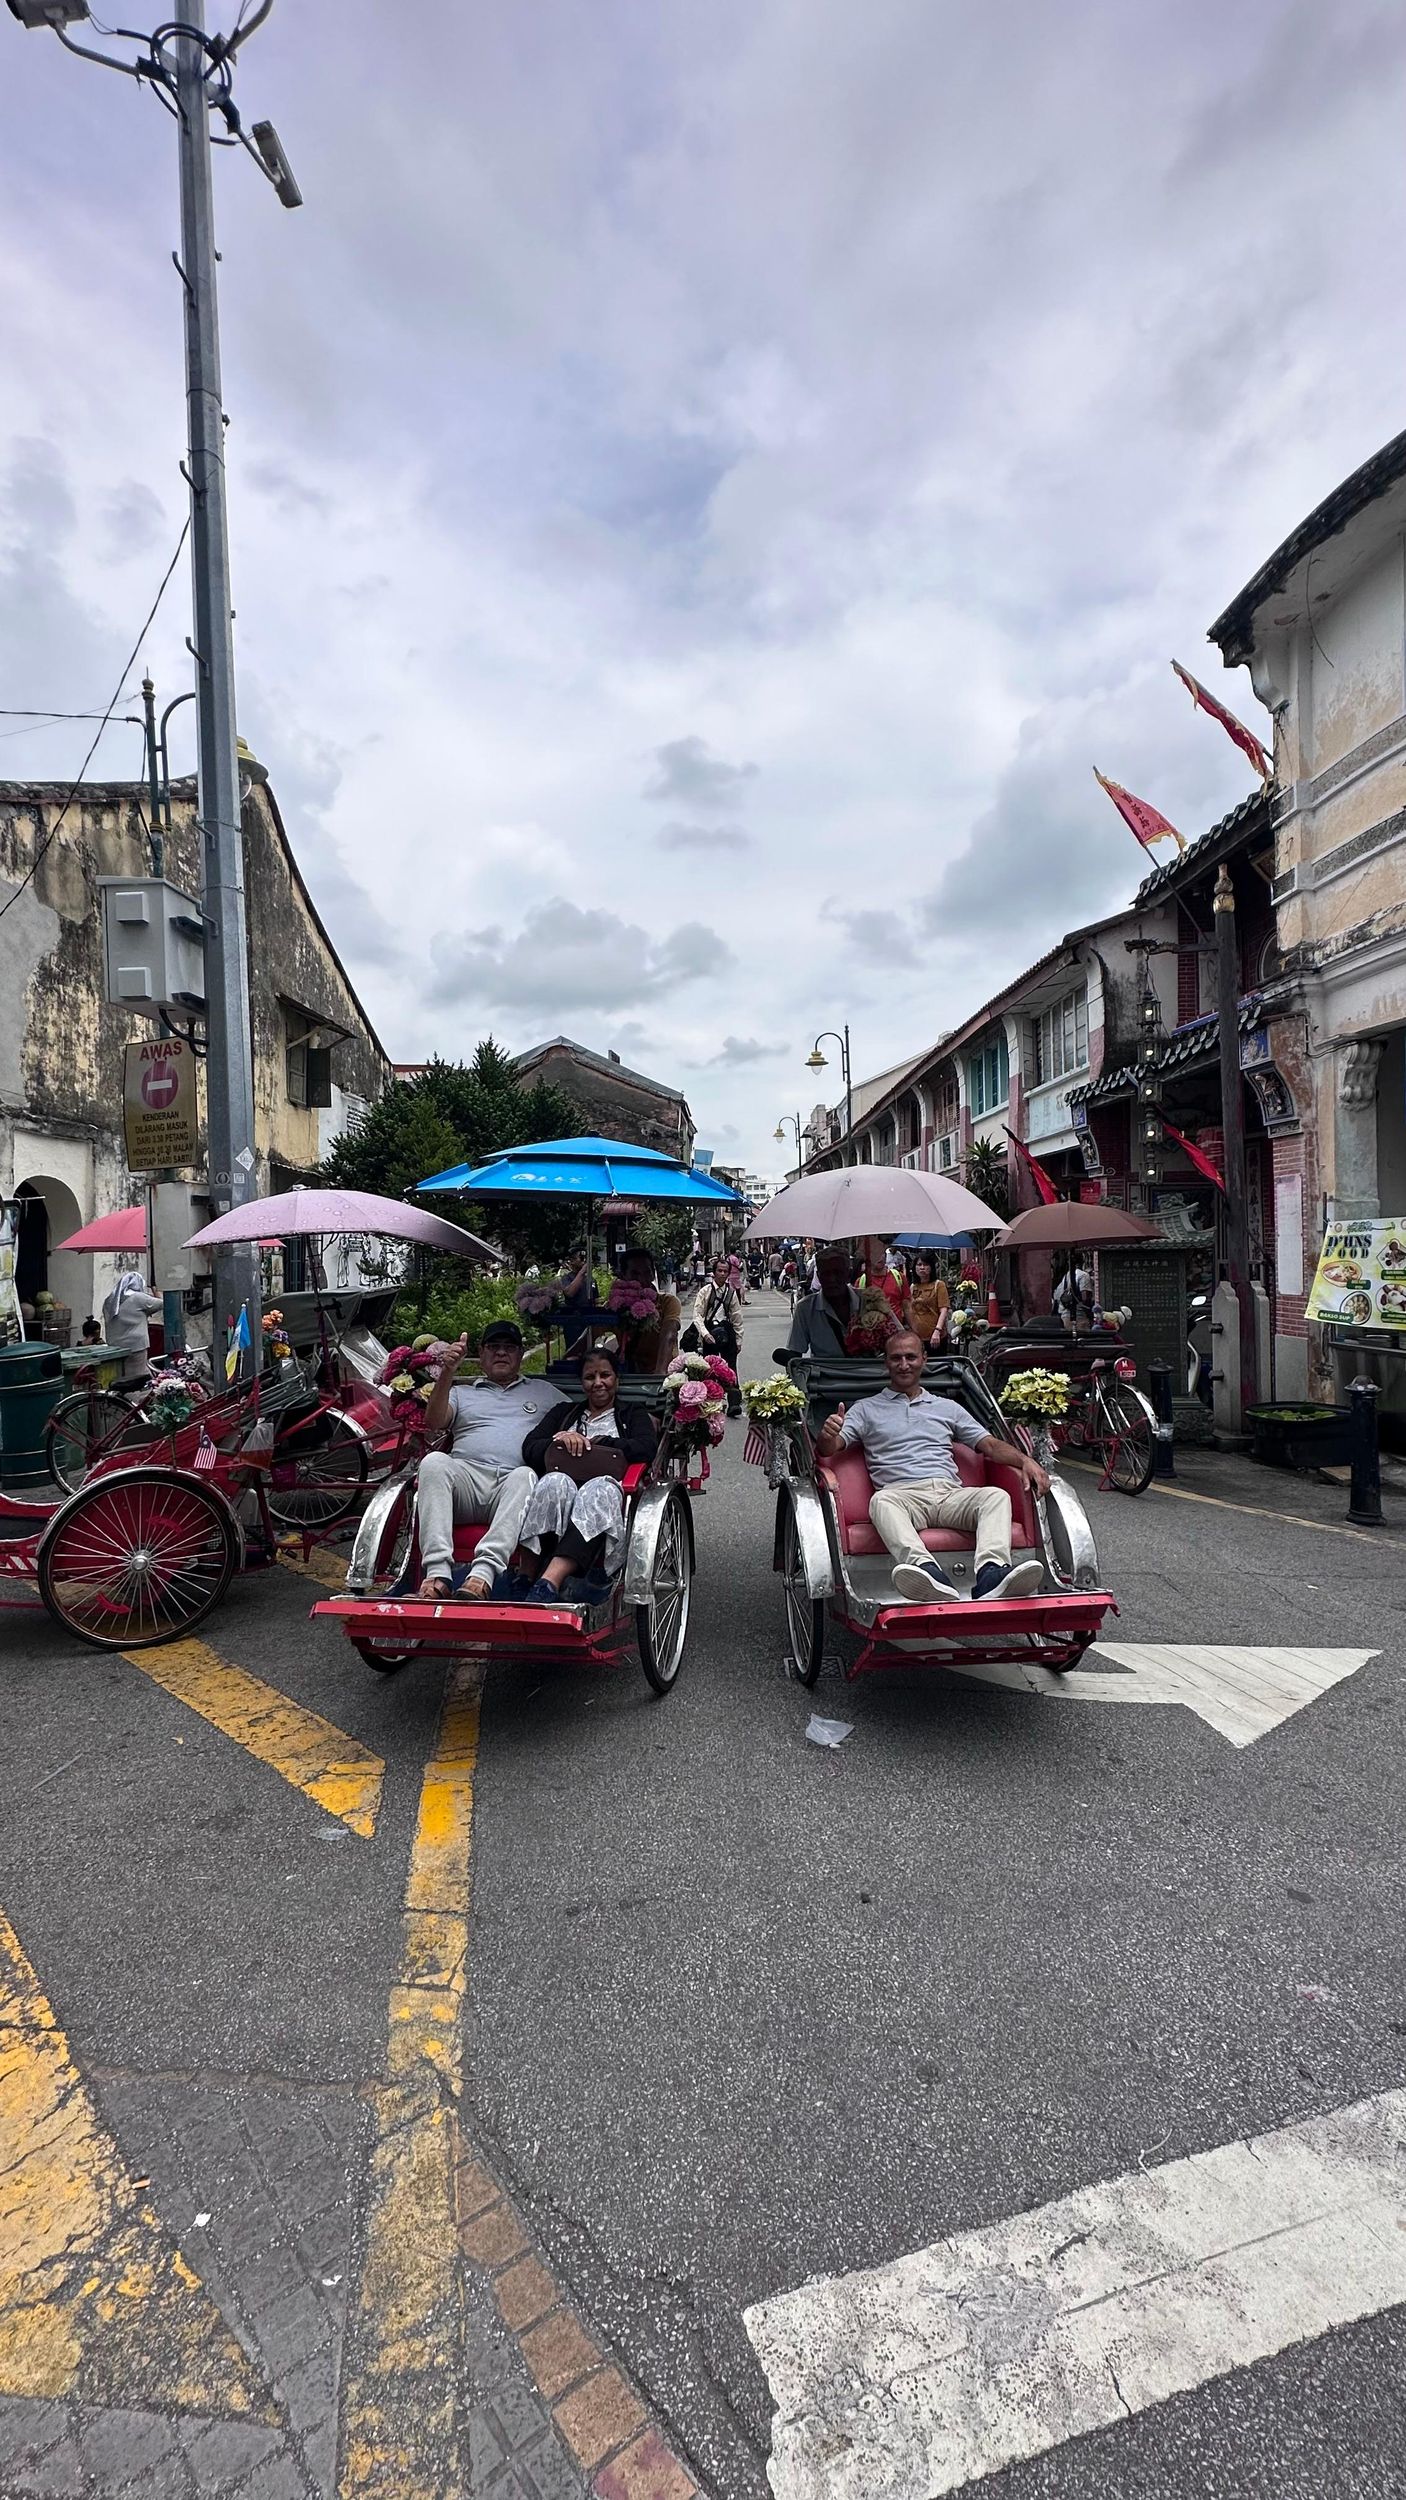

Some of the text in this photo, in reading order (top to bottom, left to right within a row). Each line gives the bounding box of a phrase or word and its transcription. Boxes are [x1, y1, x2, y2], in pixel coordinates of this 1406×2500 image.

[139, 1041, 182, 1061] AWAS
[166, 1120, 188, 1130] MASUK
[165, 1132, 189, 1142] PETANG
[1323, 1247, 1369, 1259] FOOD
